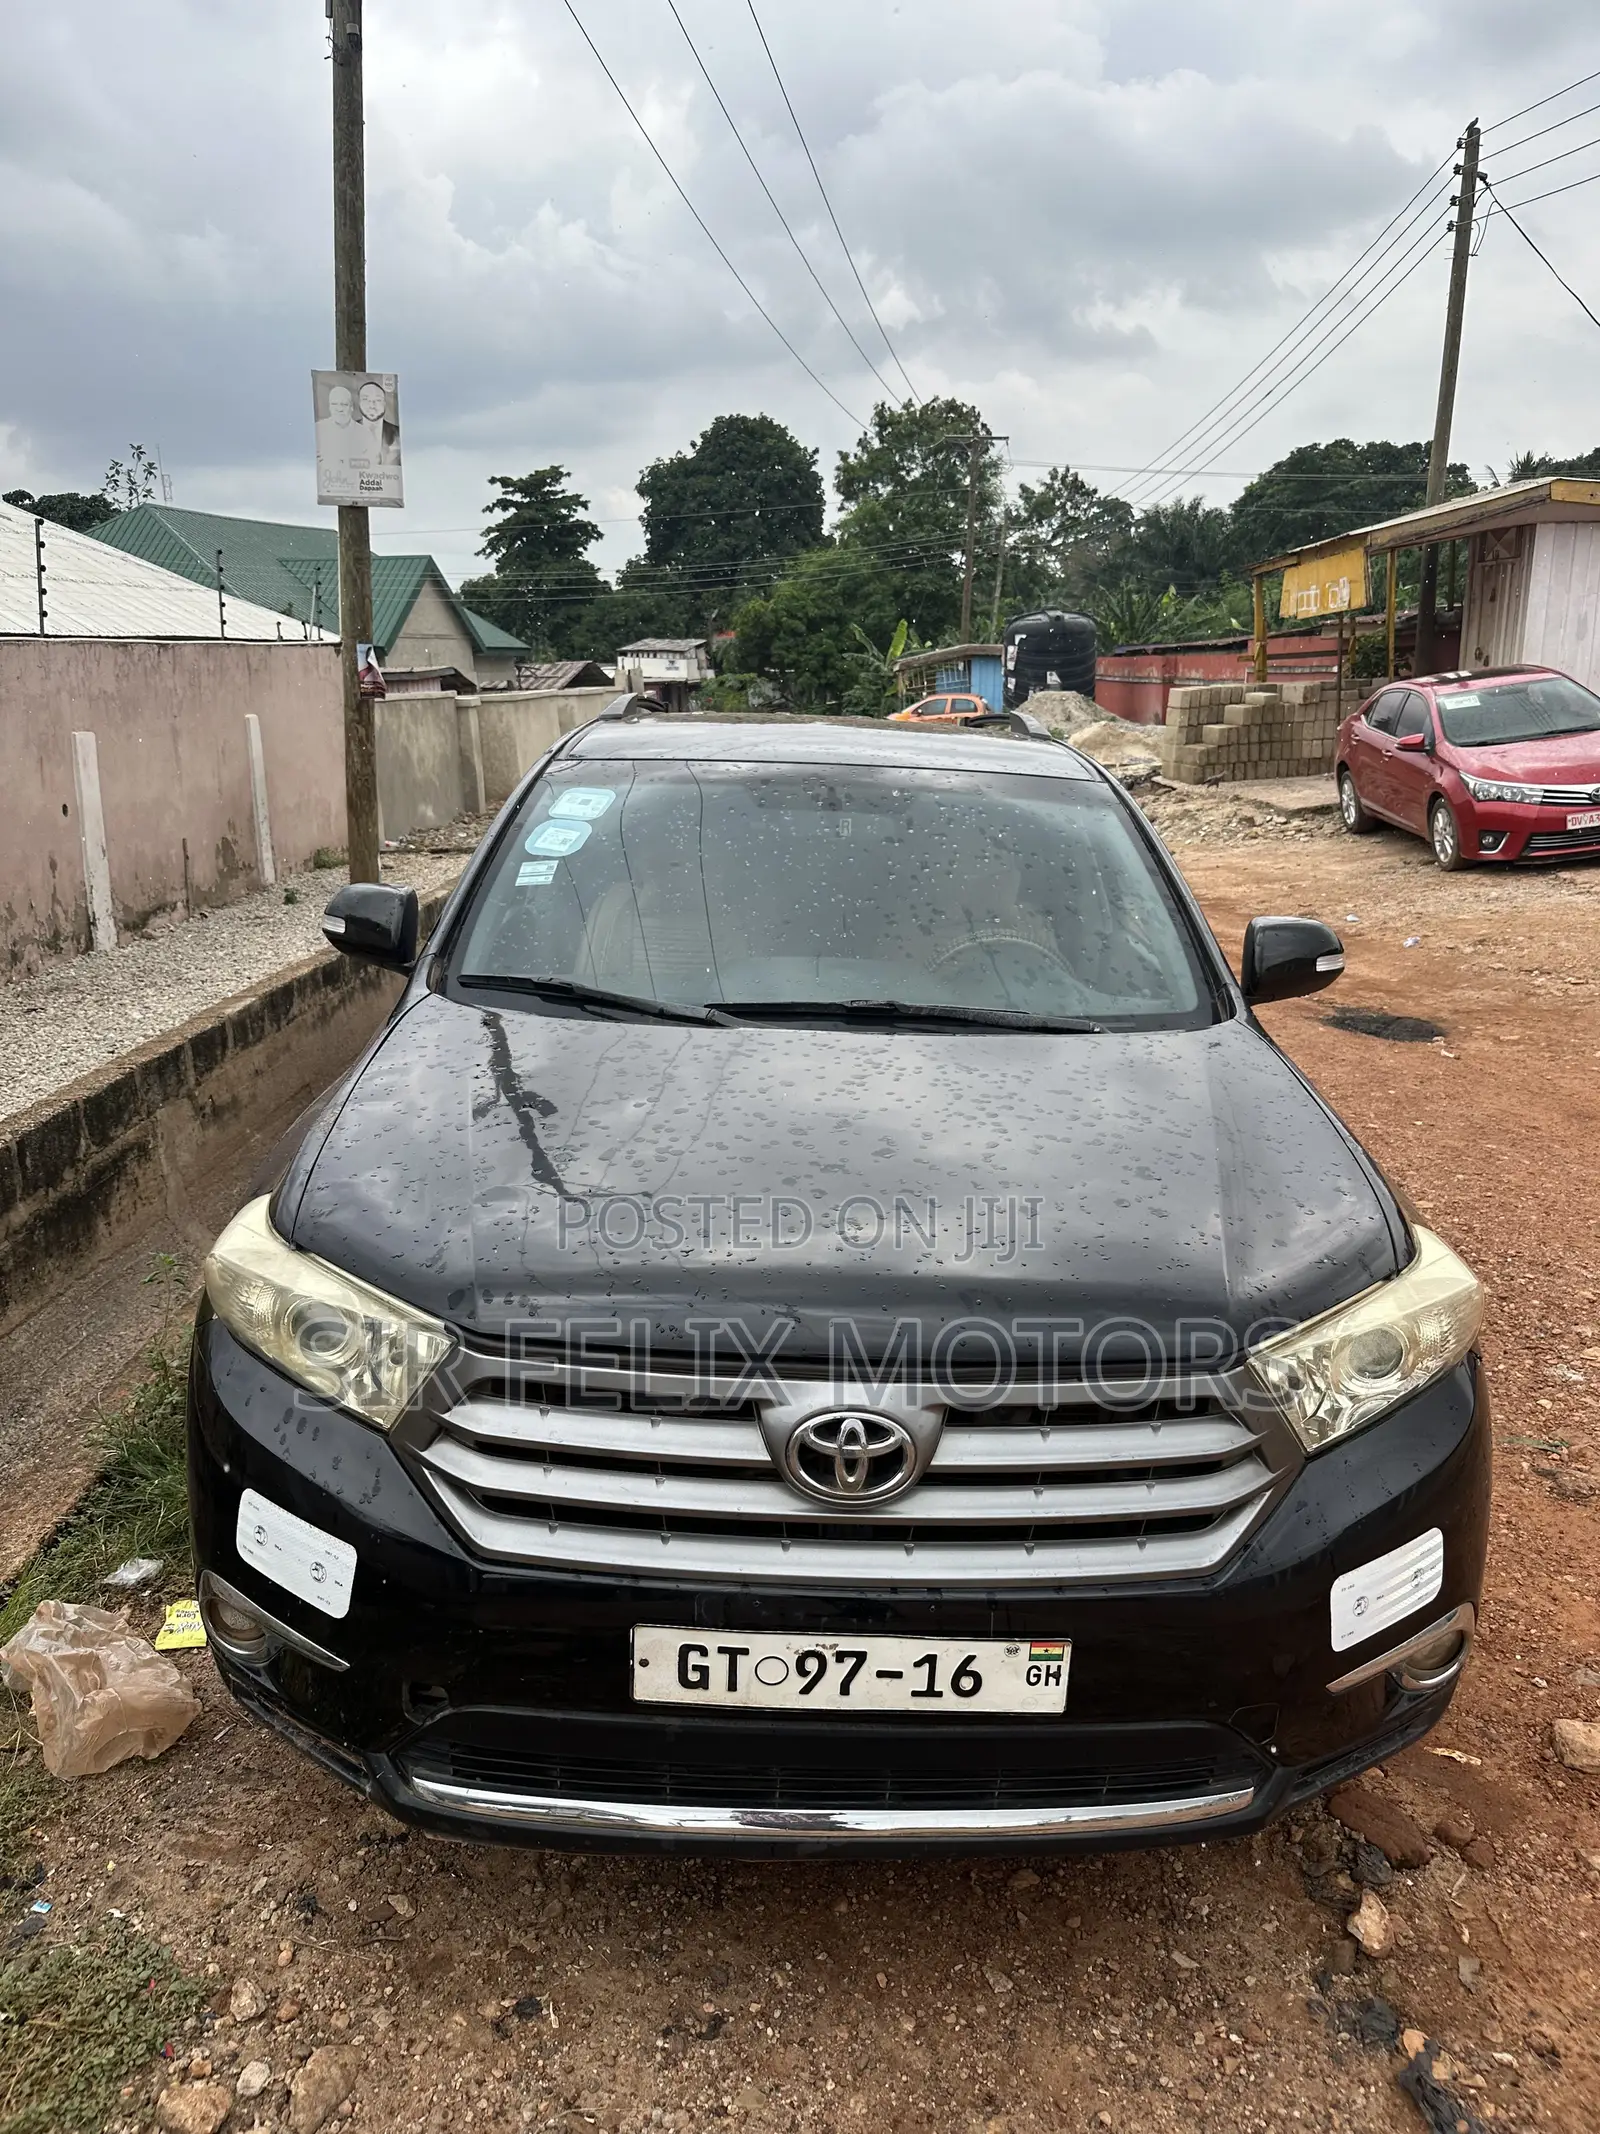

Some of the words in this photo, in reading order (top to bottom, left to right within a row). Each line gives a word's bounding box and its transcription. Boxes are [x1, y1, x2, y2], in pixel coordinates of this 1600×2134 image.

[676, 1643, 750, 1693] GT
[794, 1649, 983, 1698] 97-16
[1025, 1664, 1062, 1687] GH
